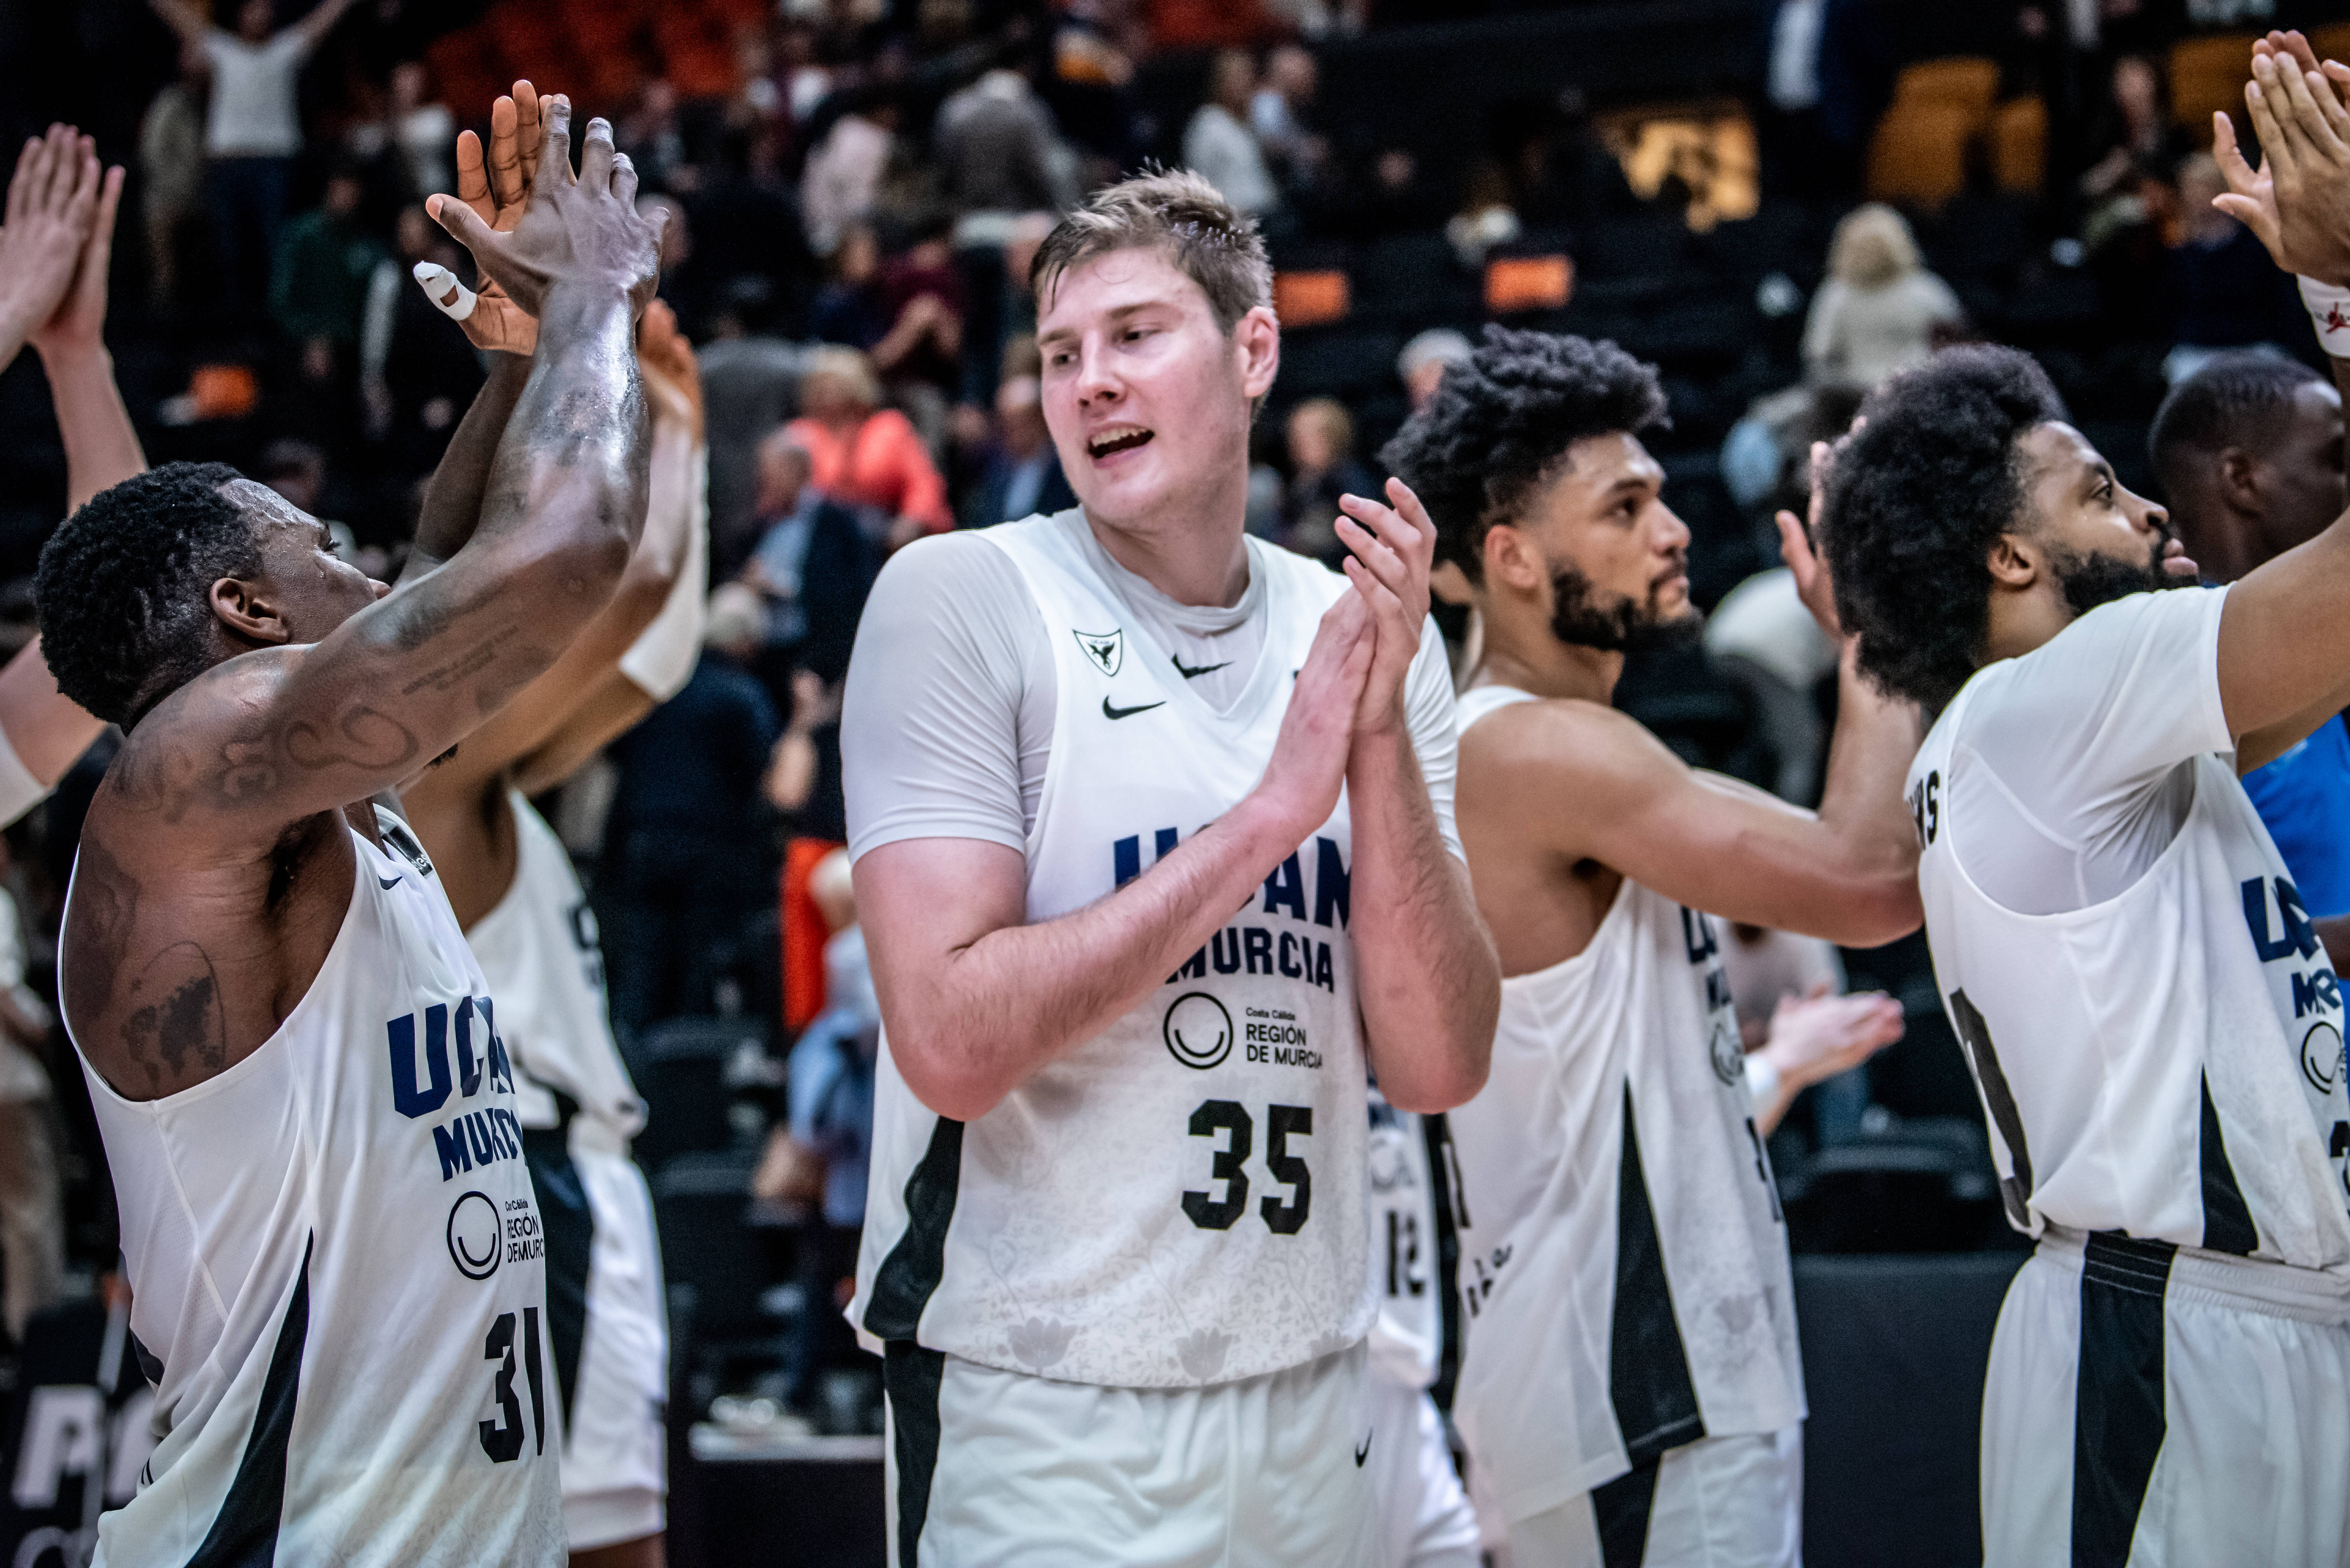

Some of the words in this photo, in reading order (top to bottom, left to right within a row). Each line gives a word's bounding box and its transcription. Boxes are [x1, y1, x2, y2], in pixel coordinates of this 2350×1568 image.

[1246, 1023, 1306, 1046] REGIÓN
[1247, 1043, 1269, 1063] DE
[1274, 1046, 1323, 1069] MURCIA
[1181, 1099, 1313, 1235] 35
[507, 1212, 539, 1239] REGIÓN
[507, 1243, 518, 1263] DE
[518, 1237, 544, 1261] MURC
[479, 1307, 545, 1463] 31
